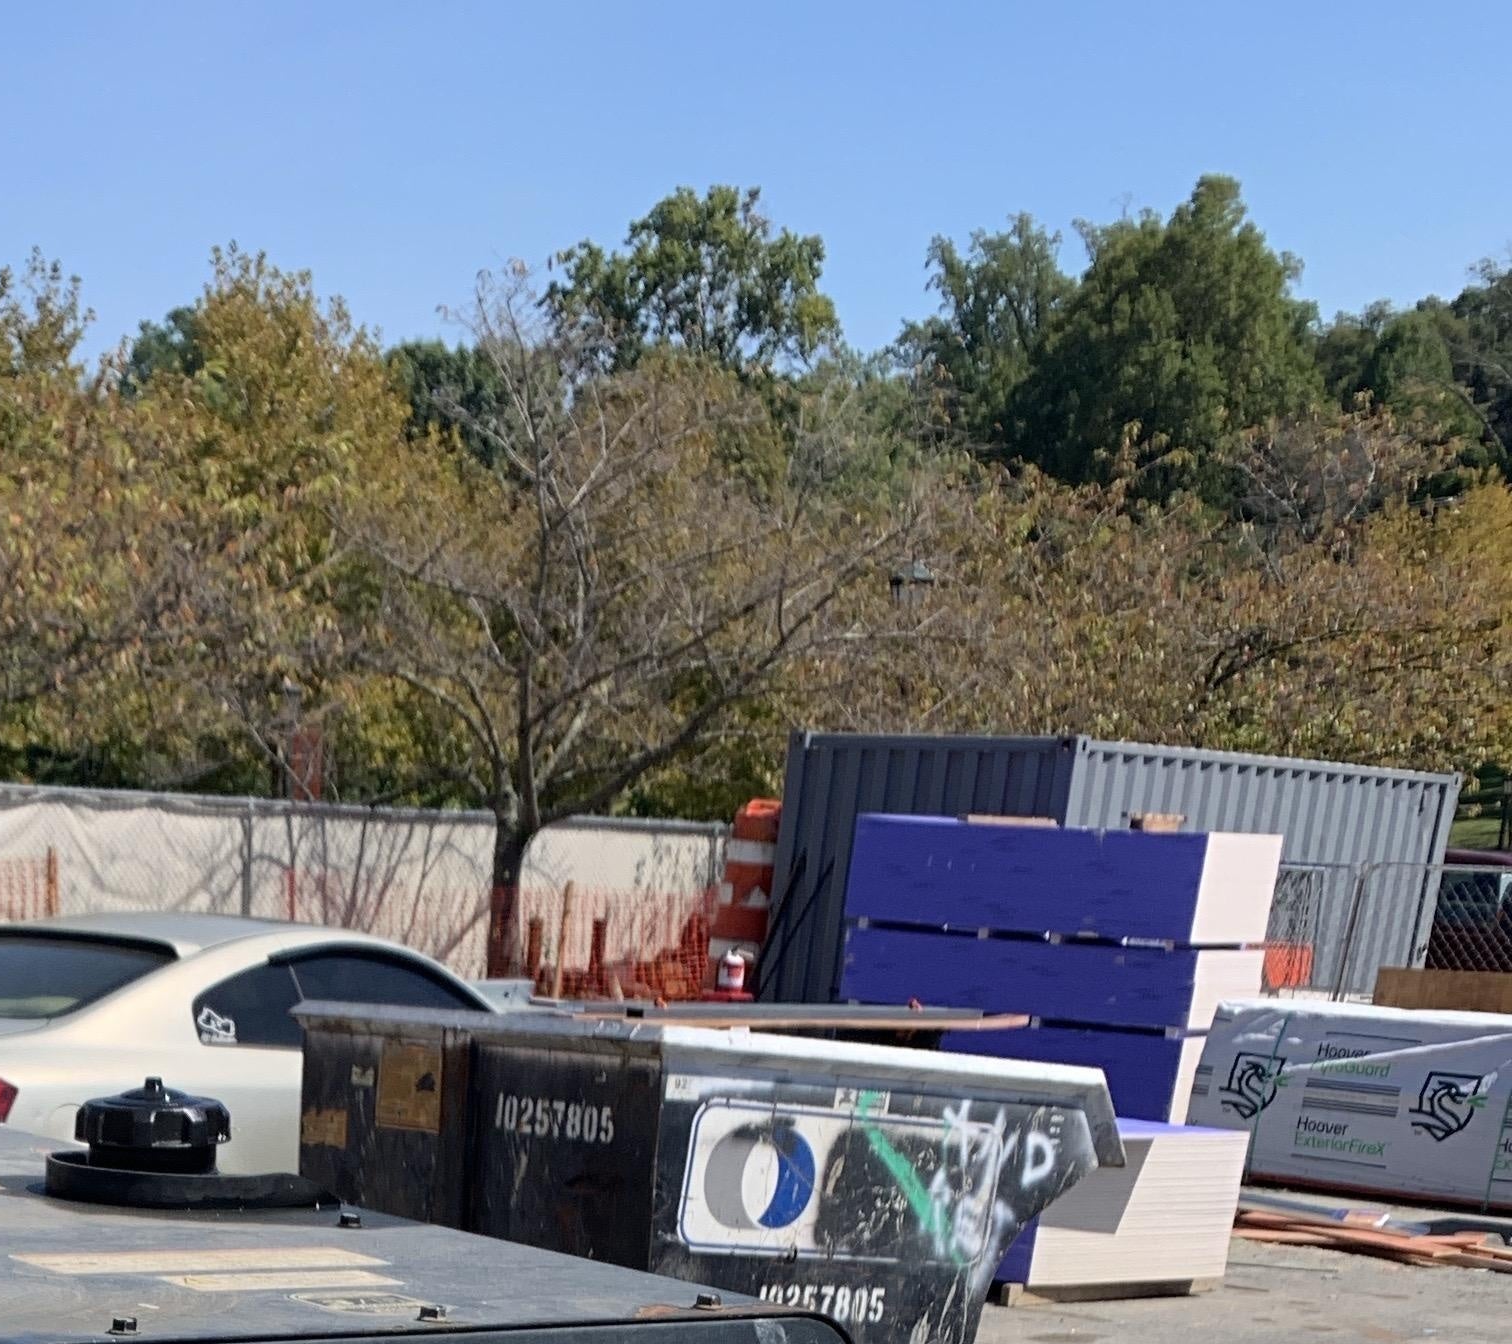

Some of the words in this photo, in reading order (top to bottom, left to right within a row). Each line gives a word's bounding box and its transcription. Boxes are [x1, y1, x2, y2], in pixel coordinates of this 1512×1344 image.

[495, 1090, 615, 1144] 10257805
[1296, 1115, 1349, 1136] Hoover
[1294, 1133, 1387, 1157] ExteriorFireX
